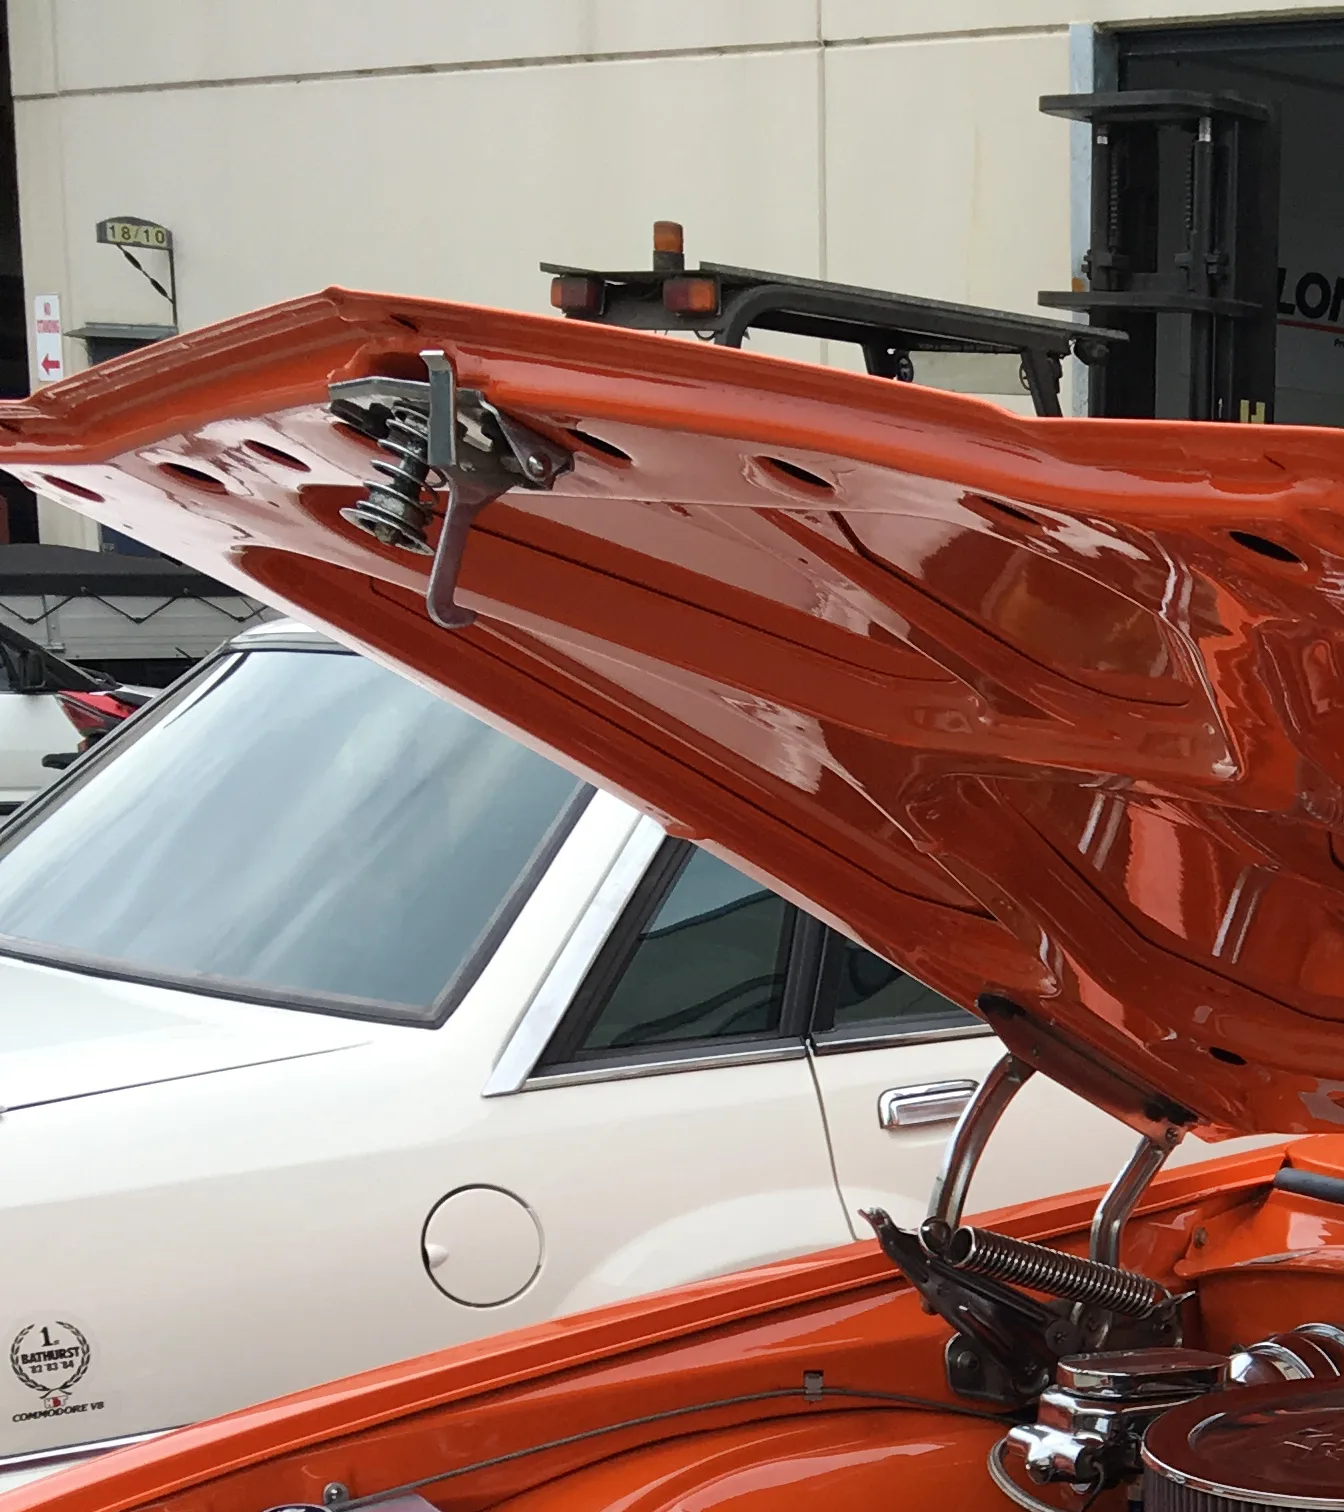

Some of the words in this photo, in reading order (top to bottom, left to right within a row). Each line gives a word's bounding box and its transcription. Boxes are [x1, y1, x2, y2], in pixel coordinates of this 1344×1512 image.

[109, 225, 165, 244] 18/10
[21, 1346, 80, 1365] BATHURST
[12, 1403, 89, 1423] COMMODORE
[90, 1401, 105, 1411] V8
